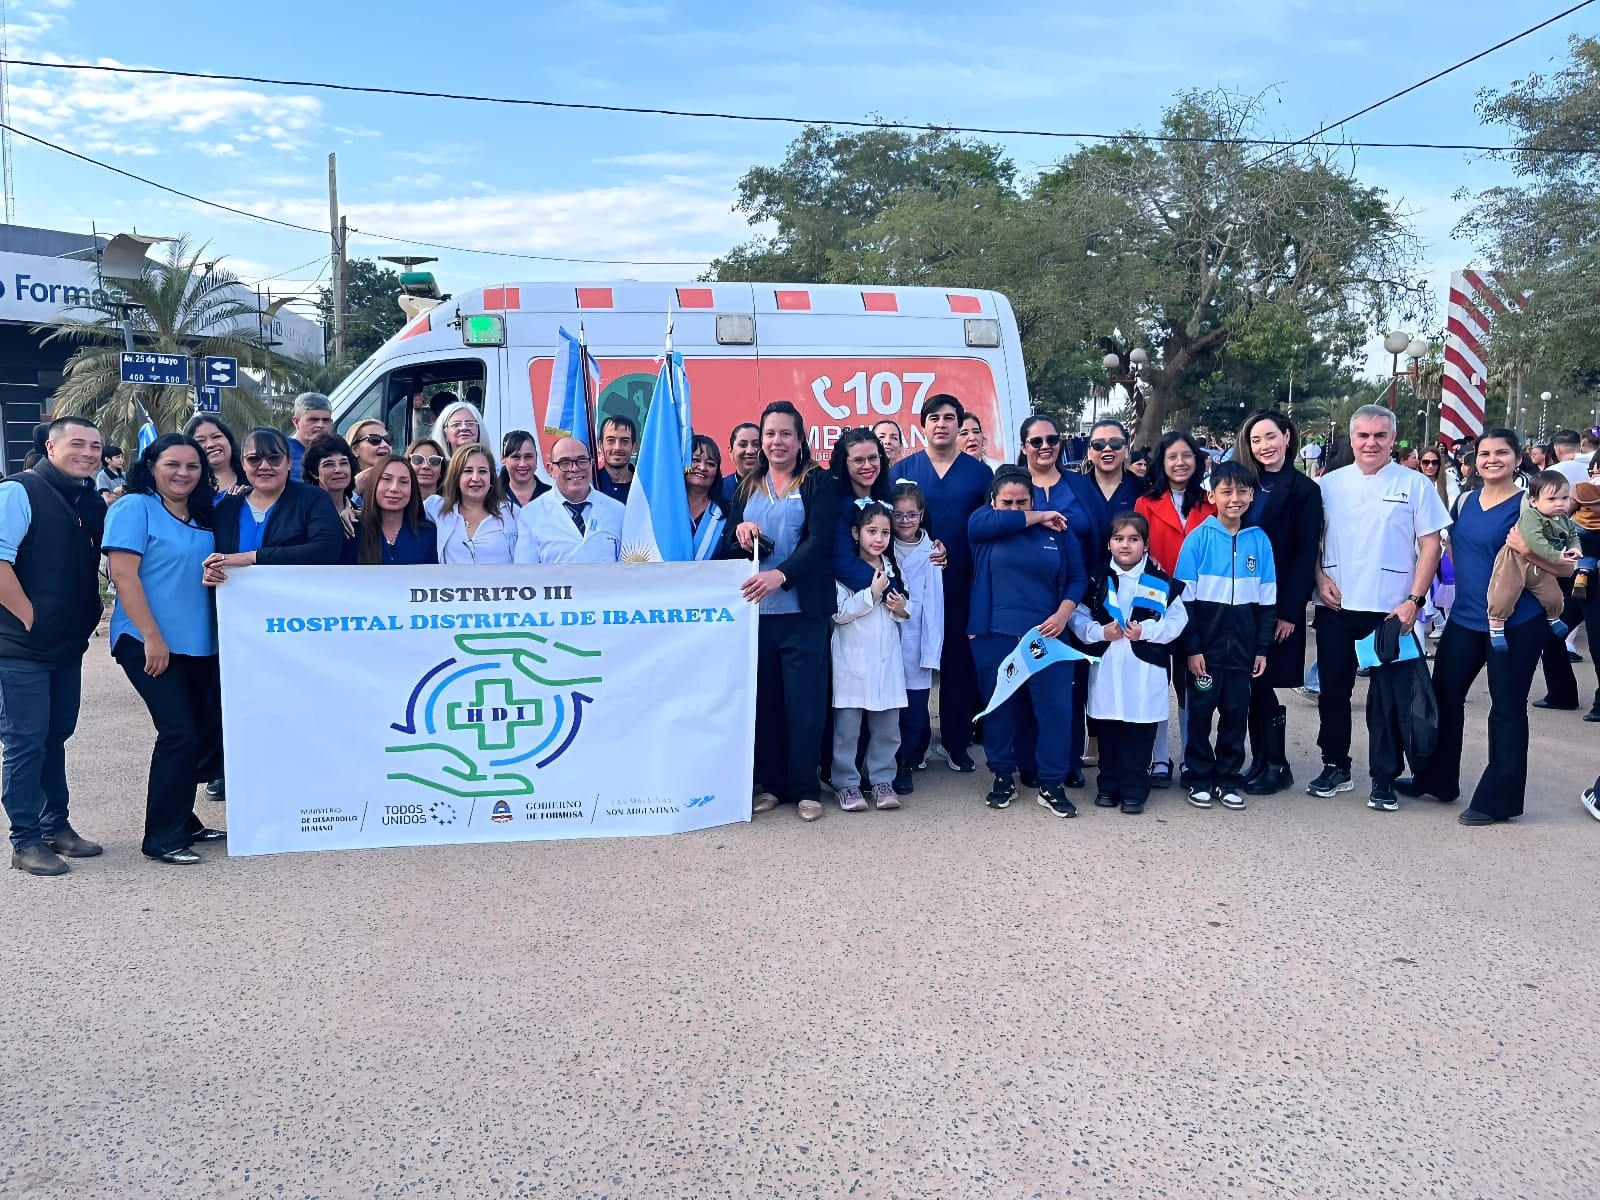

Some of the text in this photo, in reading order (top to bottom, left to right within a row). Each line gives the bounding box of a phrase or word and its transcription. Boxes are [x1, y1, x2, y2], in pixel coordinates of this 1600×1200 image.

[135, 355, 144, 363] 25
[158, 356, 178, 366] Mayo
[843, 371, 936, 415] 107
[409, 585, 573, 603] DISTRITO III
[266, 607, 735, 633] HOSPITAL DISTRITAL DE IBARRETA
[384, 804, 424, 815] TODOS
[526, 800, 582, 810] GOBIERNO
[526, 810, 583, 820] DE FORMOSA
[605, 806, 680, 816] SON ARGENTINAS
[312, 815, 358, 823] DESARROLLO
[382, 814, 427, 826] UNIDOS
[301, 825, 333, 833] HUMANO
